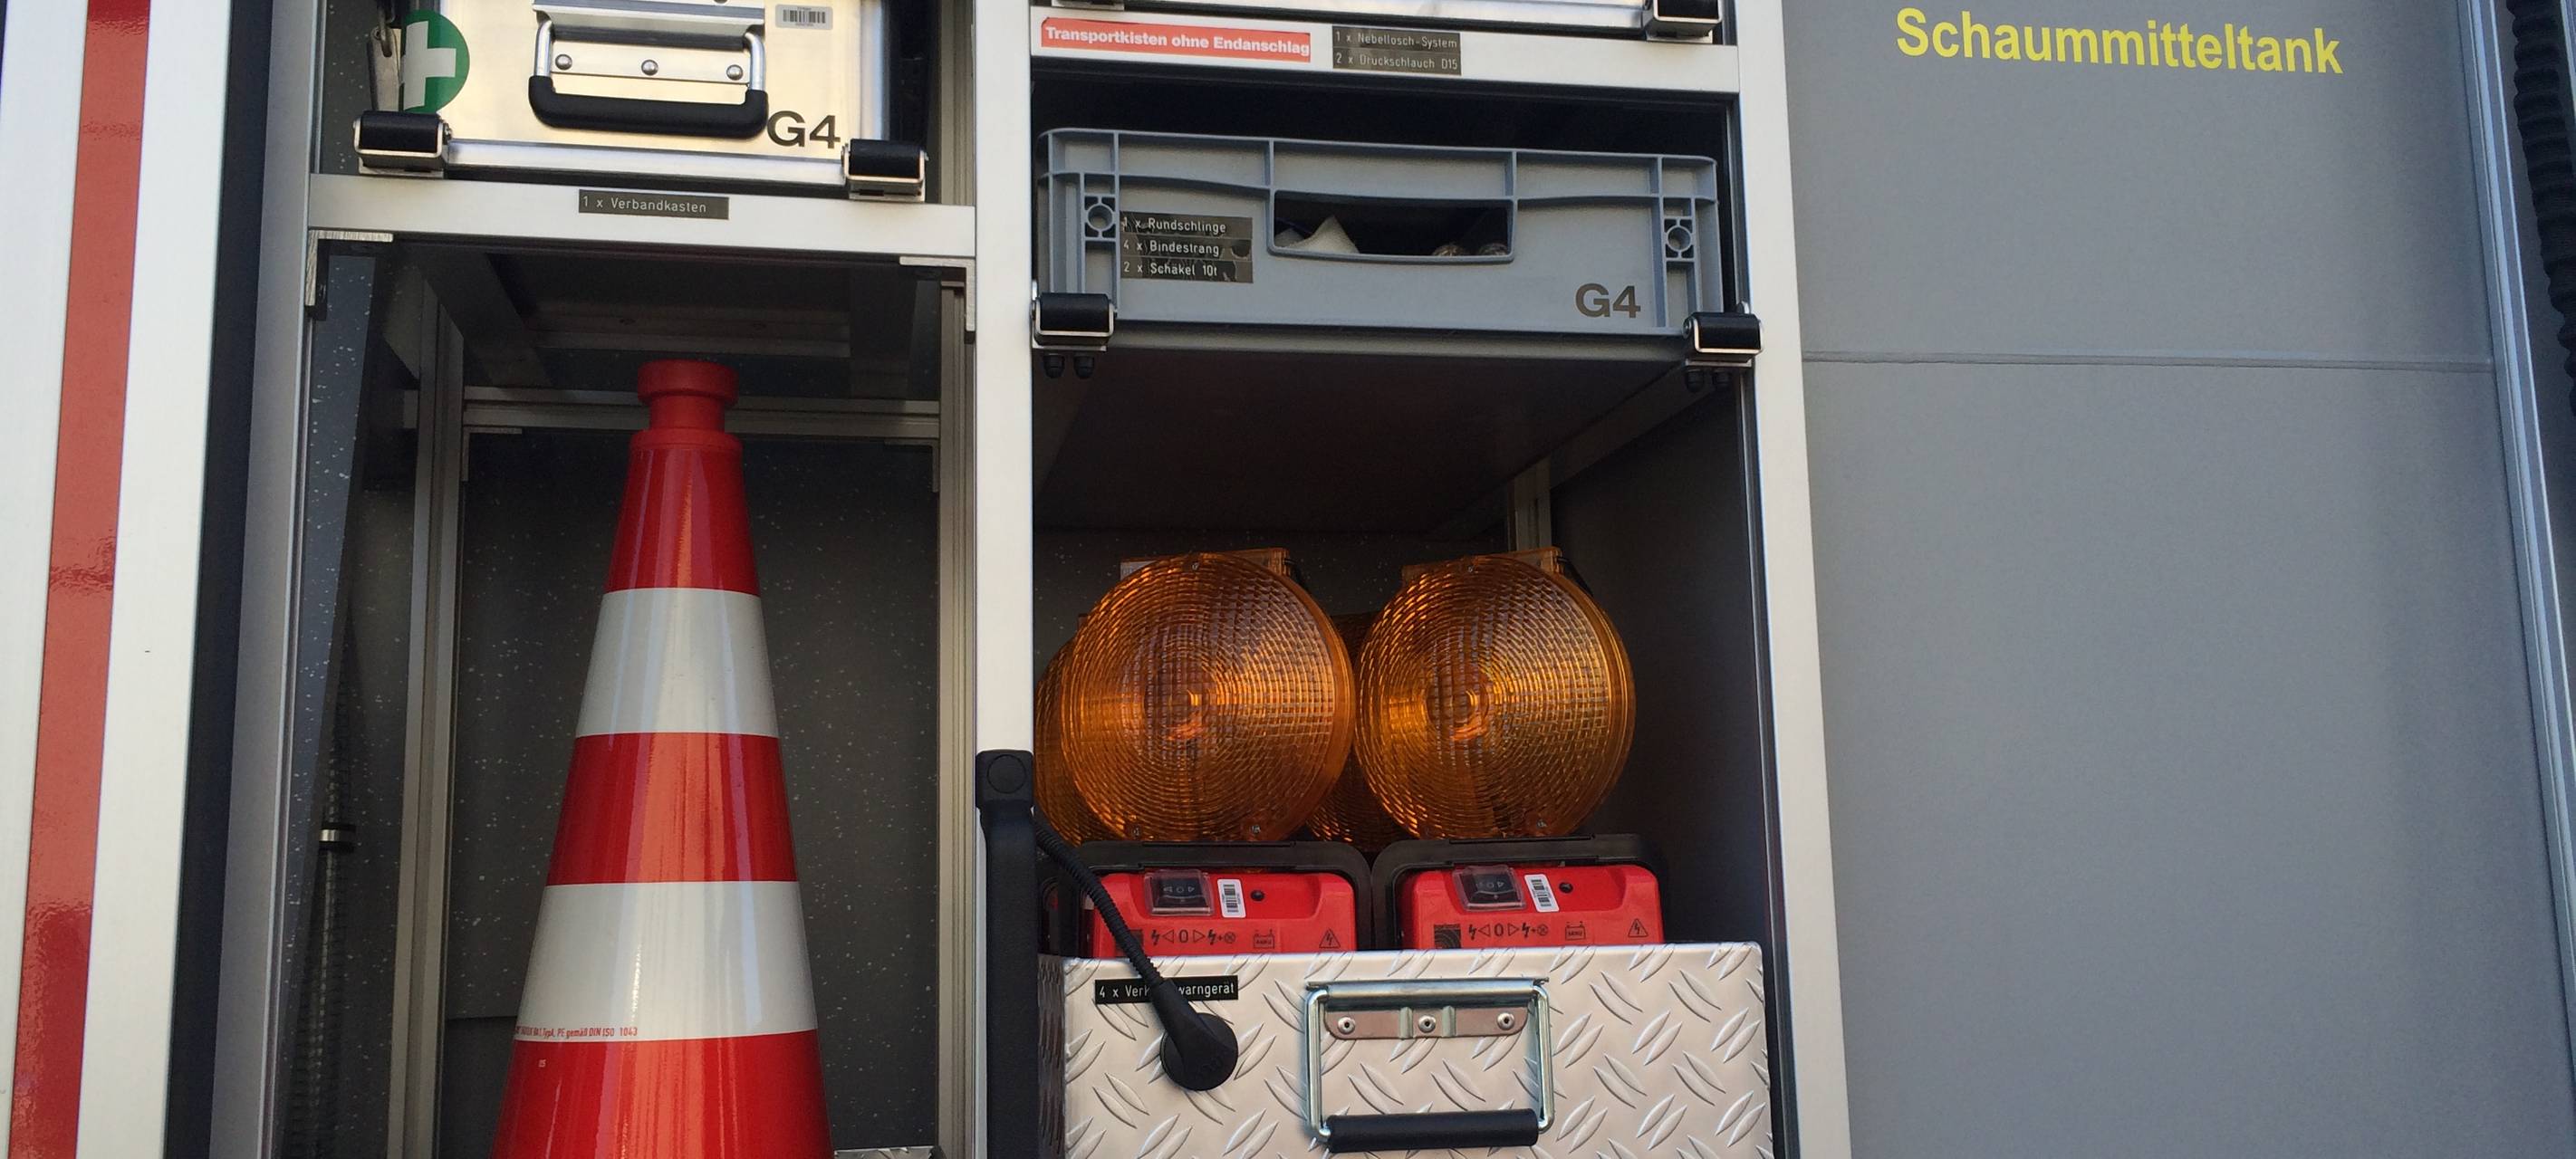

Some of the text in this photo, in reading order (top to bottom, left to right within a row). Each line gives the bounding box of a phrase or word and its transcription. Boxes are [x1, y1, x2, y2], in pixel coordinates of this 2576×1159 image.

[1045, 25, 1310, 57] Transportkisten ohne Endanschlag
[1335, 31, 1341, 42] 1
[1346, 34, 1352, 43] x
[1896, 7, 2344, 74] Schaummitteltank
[1336, 53, 1342, 64] 2
[1360, 54, 1436, 69] Druckschlauch
[1441, 58, 1457, 70] D15
[767, 110, 841, 149] G4
[582, 196, 706, 213] 1 x Verbandkasten
[1122, 216, 1128, 228] 1
[1148, 217, 1226, 235] Rundschlinge
[1123, 239, 1219, 257] 4 x Bindestrang
[1123, 262, 1217, 276] 2 x Schäkel 10t
[1575, 283, 1641, 319] G4
[1099, 985, 1105, 998] 4
[1112, 988, 1120, 998] x
[589, 1027, 602, 1038] DIN
[602, 1027, 615, 1038] ISO
